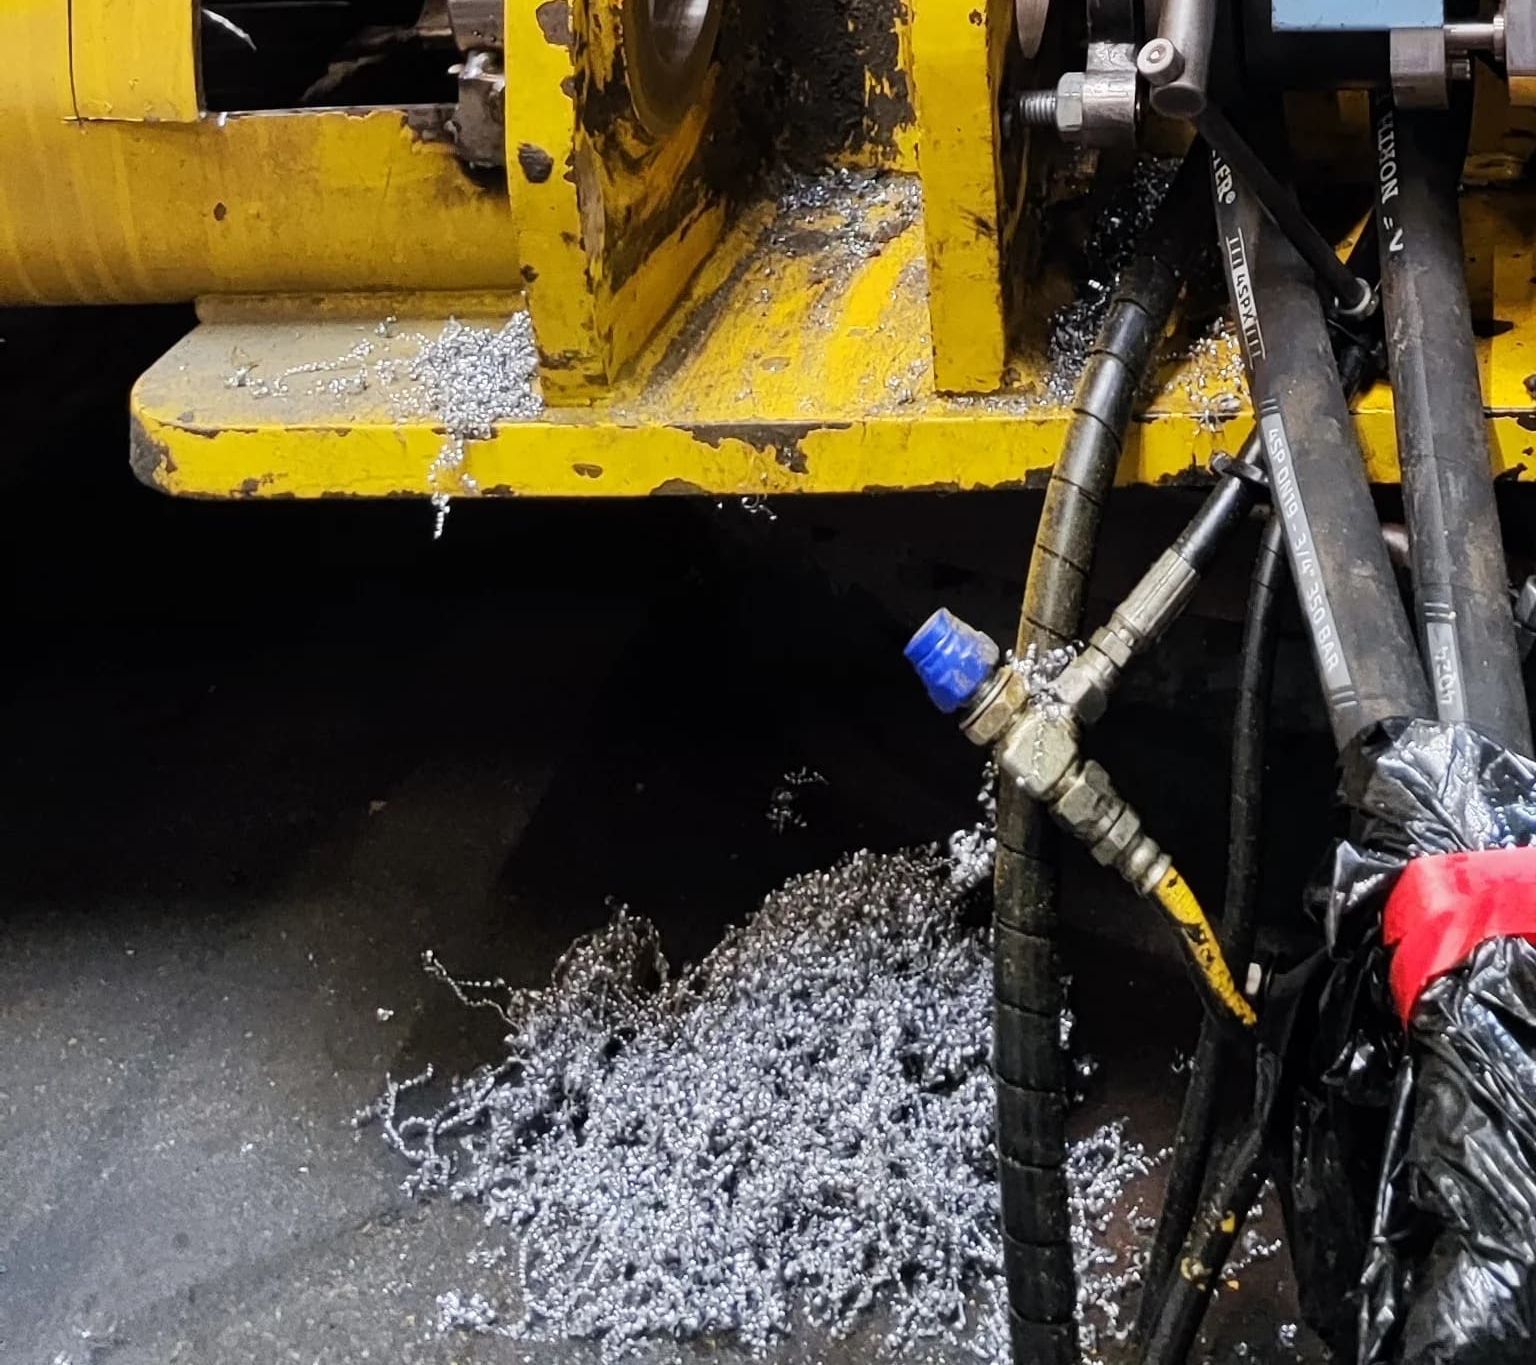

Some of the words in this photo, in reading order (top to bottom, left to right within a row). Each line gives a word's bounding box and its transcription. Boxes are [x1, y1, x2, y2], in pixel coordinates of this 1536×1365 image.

[1235, 273, 1256, 323] 4SPX
[1267, 427, 1285, 461] 4SP
[1275, 465, 1299, 519] DN19
[1305, 583, 1327, 623] 350
[1317, 624, 1340, 673] BAR
